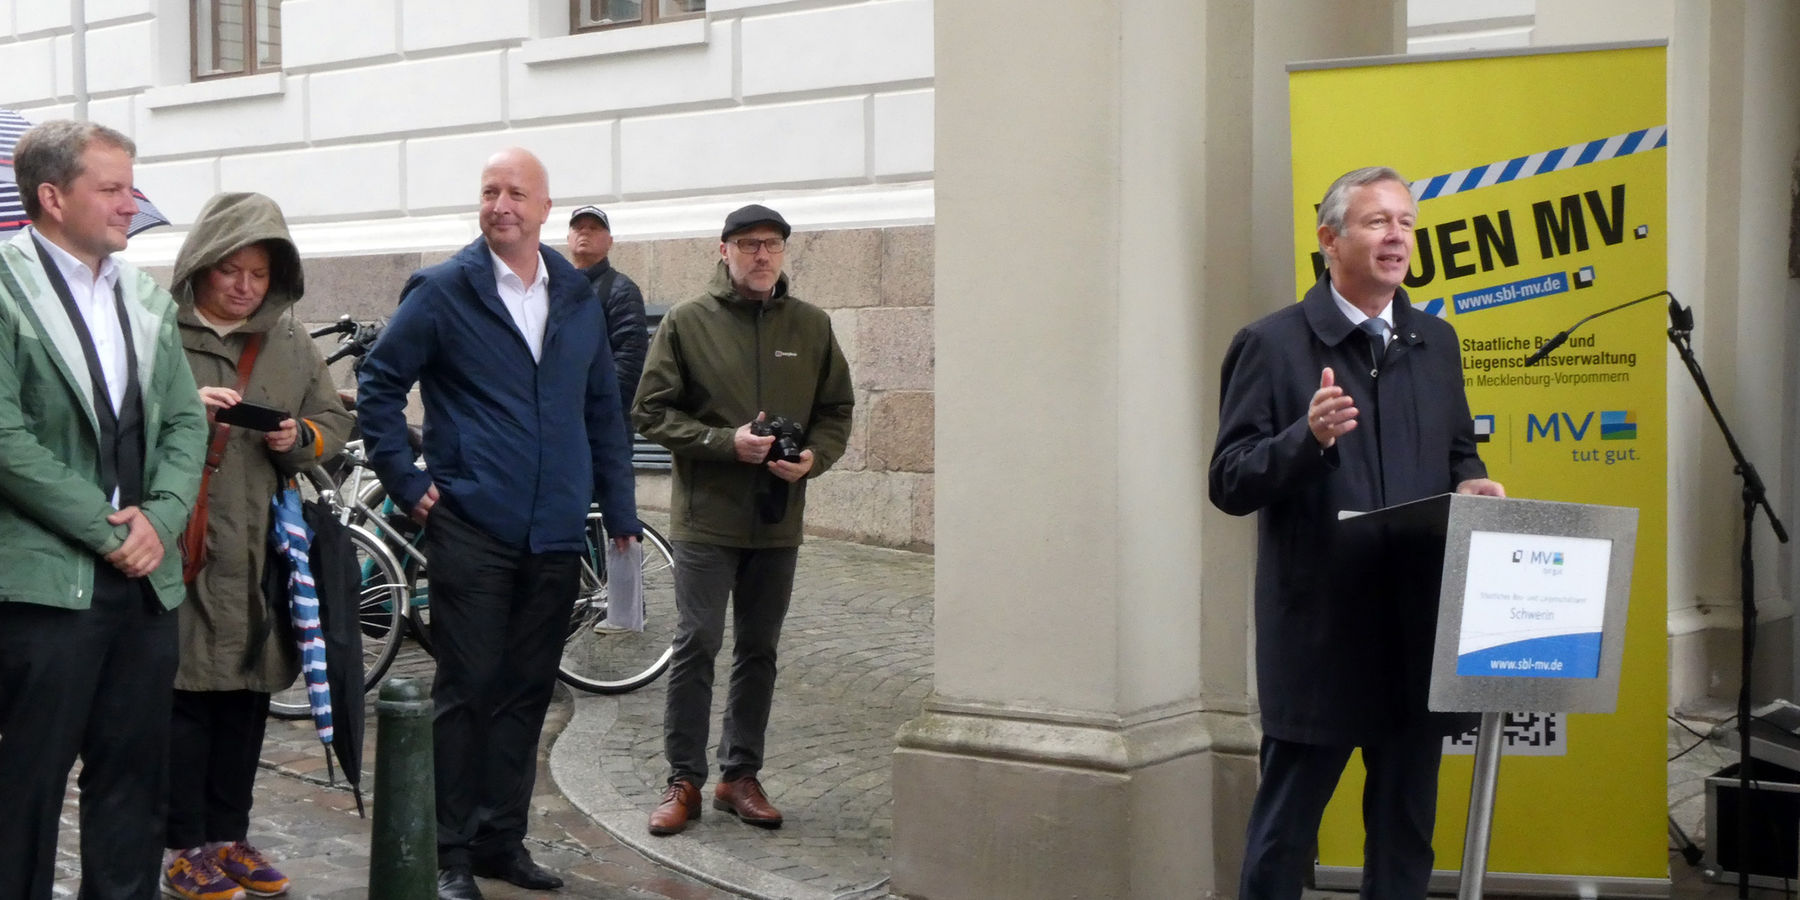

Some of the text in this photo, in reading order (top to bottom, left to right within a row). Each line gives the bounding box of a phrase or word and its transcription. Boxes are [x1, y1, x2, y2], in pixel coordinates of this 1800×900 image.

[1531, 184, 1649, 260] MV.
[1456, 276, 1562, 312] www.sbl-mv.de
[1462, 336, 1530, 352] Staatliche
[1569, 334, 1596, 349] und
[1477, 372, 1629, 388] Mecklenburg-Vorpommern
[1526, 411, 1595, 443] MV
[1572, 447, 1640, 465] tut gut.
[1530, 551, 1552, 565] MV
[1509, 607, 1555, 621] Schwerin
[1490, 658, 1563, 671] www.sbl-mv.de
